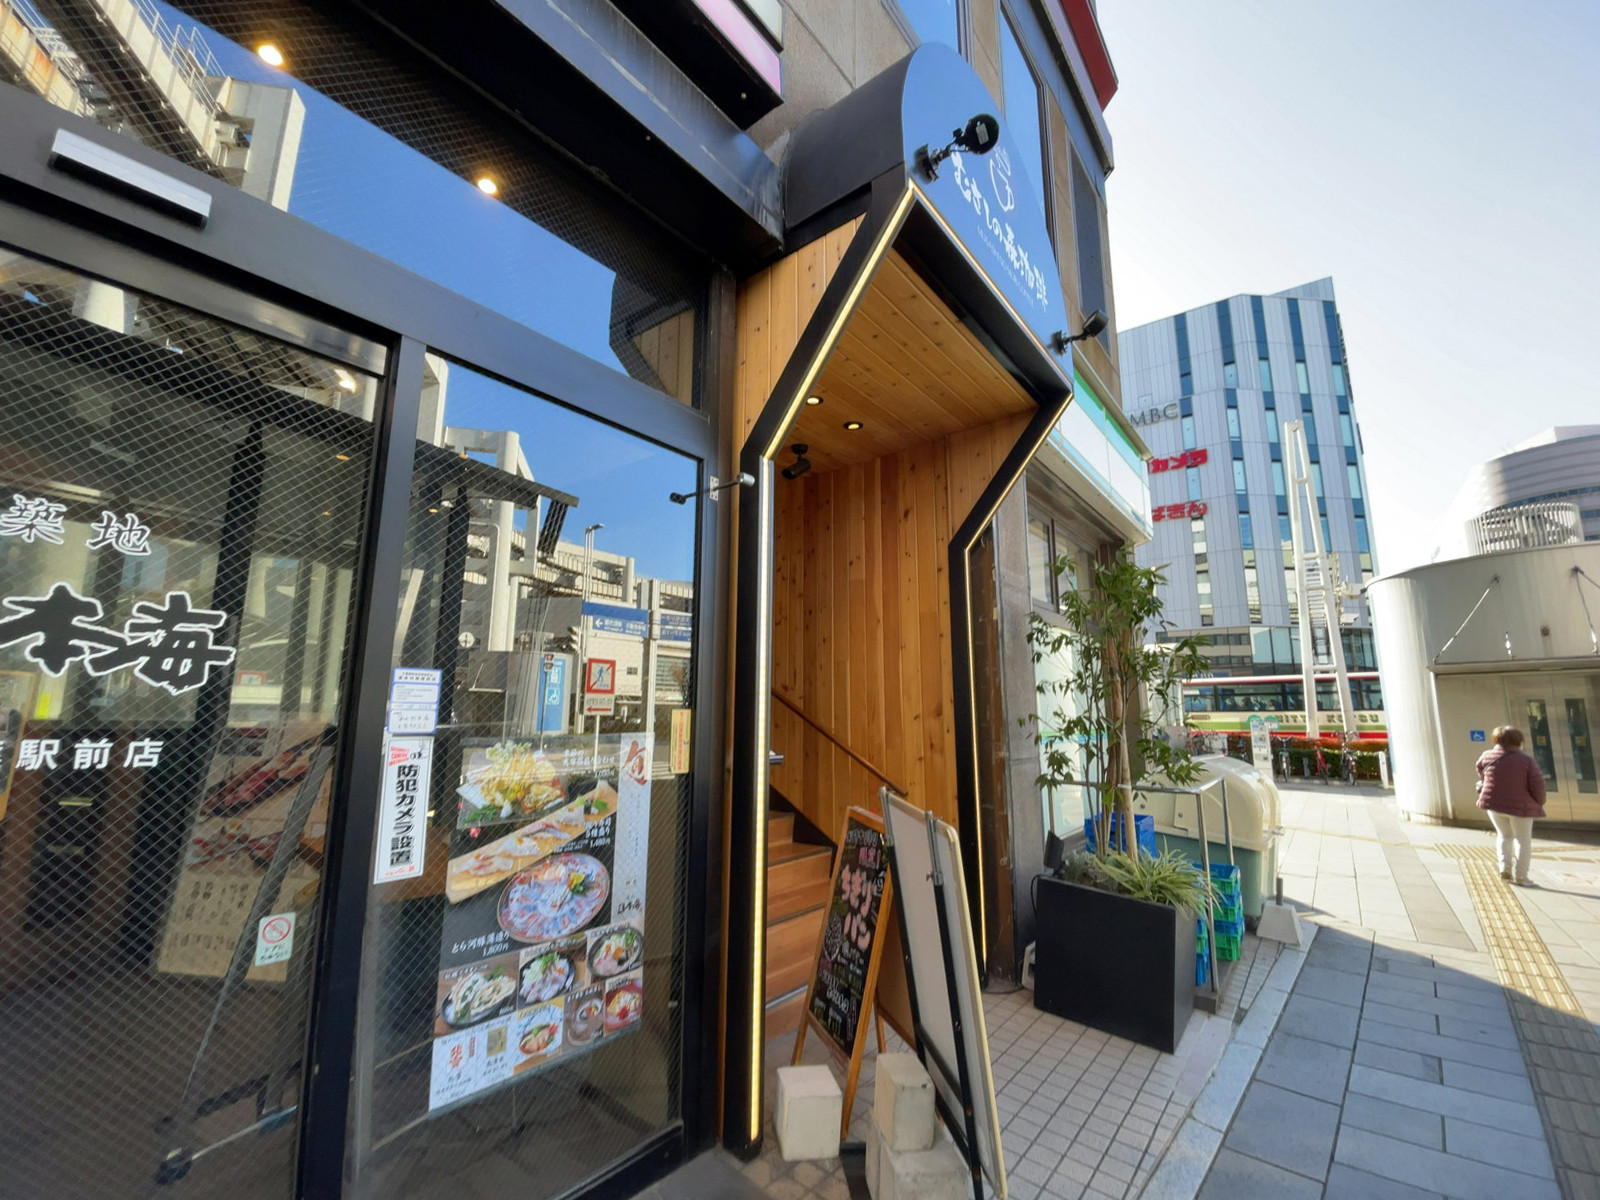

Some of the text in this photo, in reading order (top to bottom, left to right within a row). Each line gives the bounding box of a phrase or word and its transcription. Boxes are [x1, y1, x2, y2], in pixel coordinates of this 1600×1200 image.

[1147, 448, 1208, 474] カメラ
[0, 738, 164, 771] 駅前店
[390, 764, 419, 867] 防犯カメラ設置
